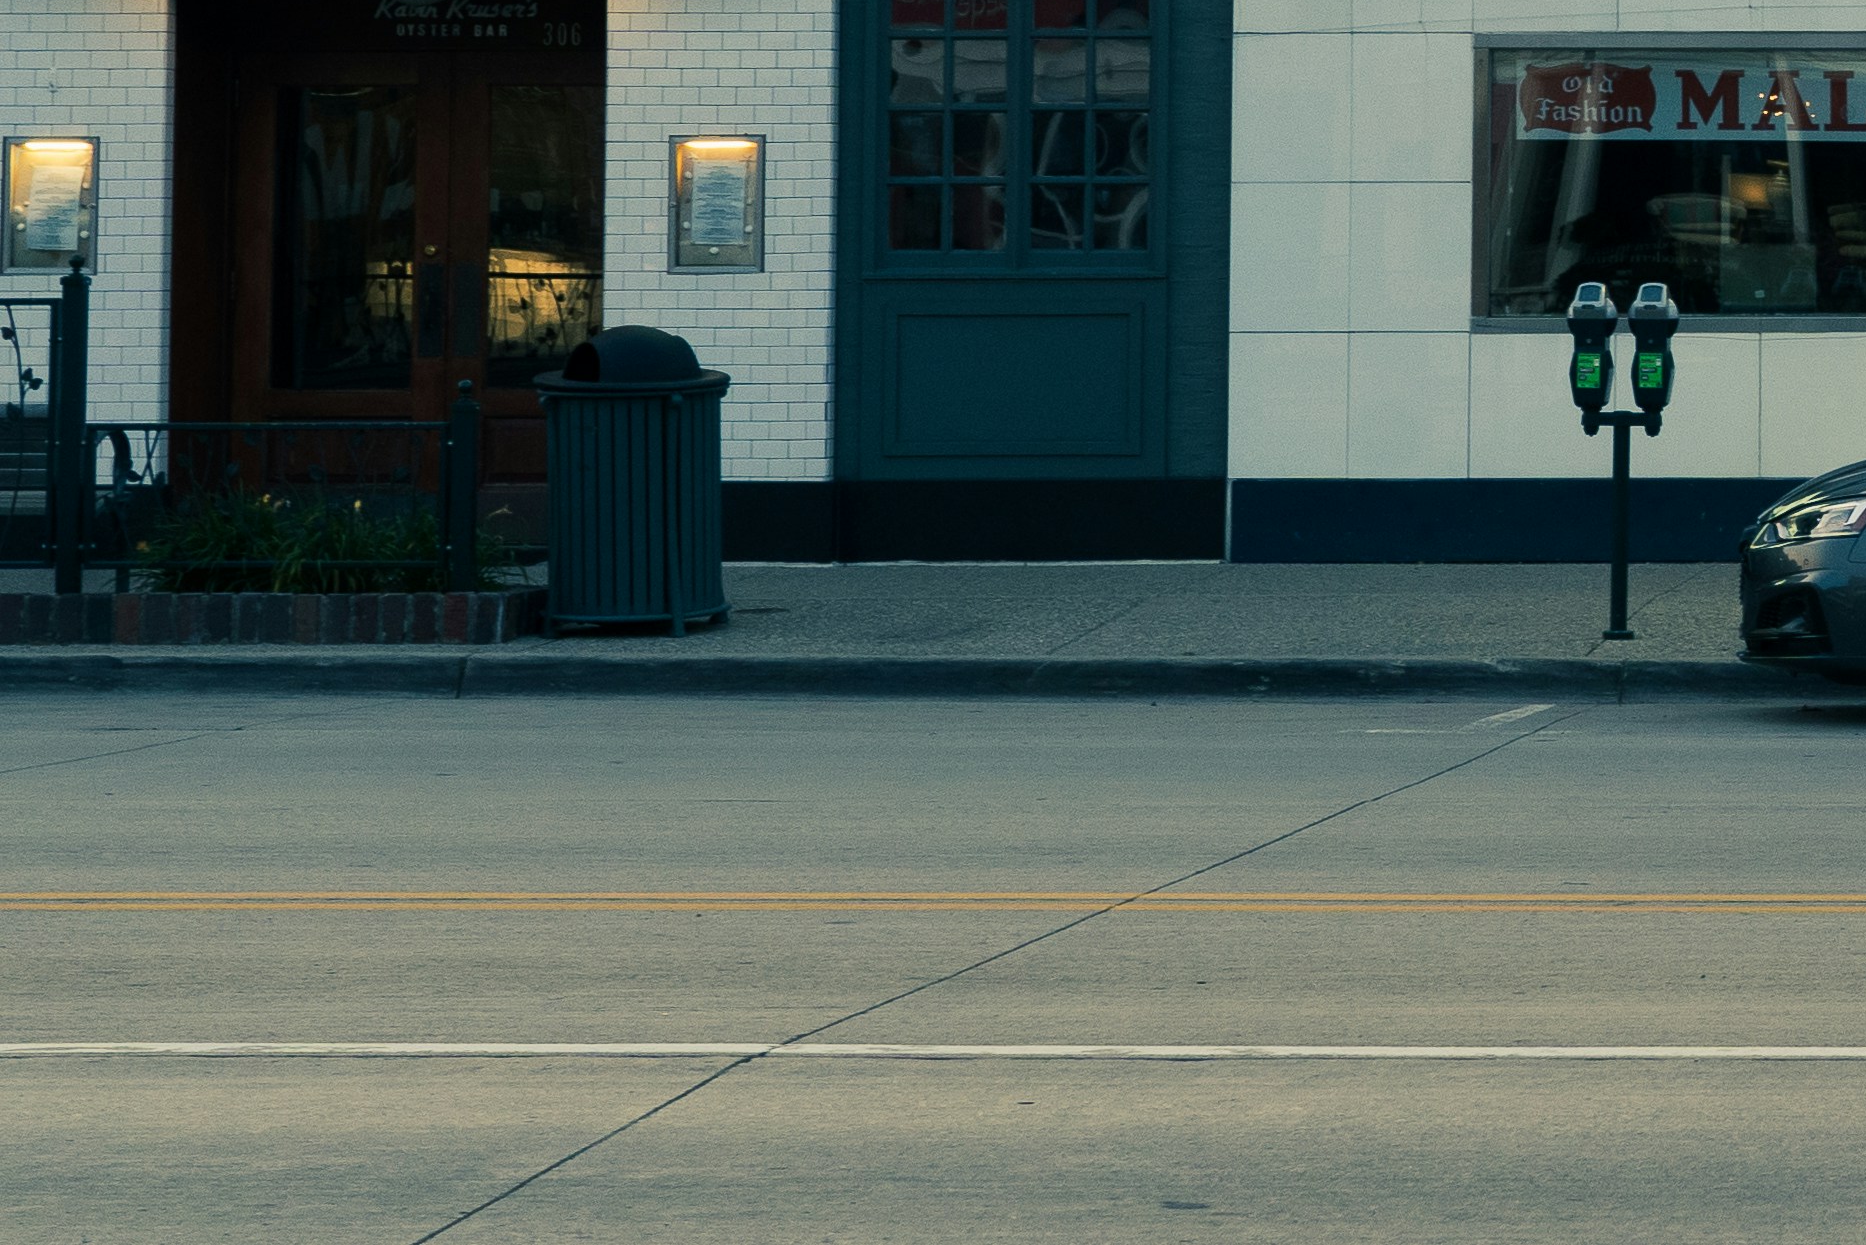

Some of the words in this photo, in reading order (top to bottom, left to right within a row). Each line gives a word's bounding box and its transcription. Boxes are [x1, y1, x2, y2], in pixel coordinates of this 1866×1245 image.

[395, 22, 461, 37] OYSTER
[473, 22, 509, 38] BAR
[542, 22, 582, 46] 306
[1562, 74, 1615, 94] Old
[1534, 97, 1643, 123] Fashion
